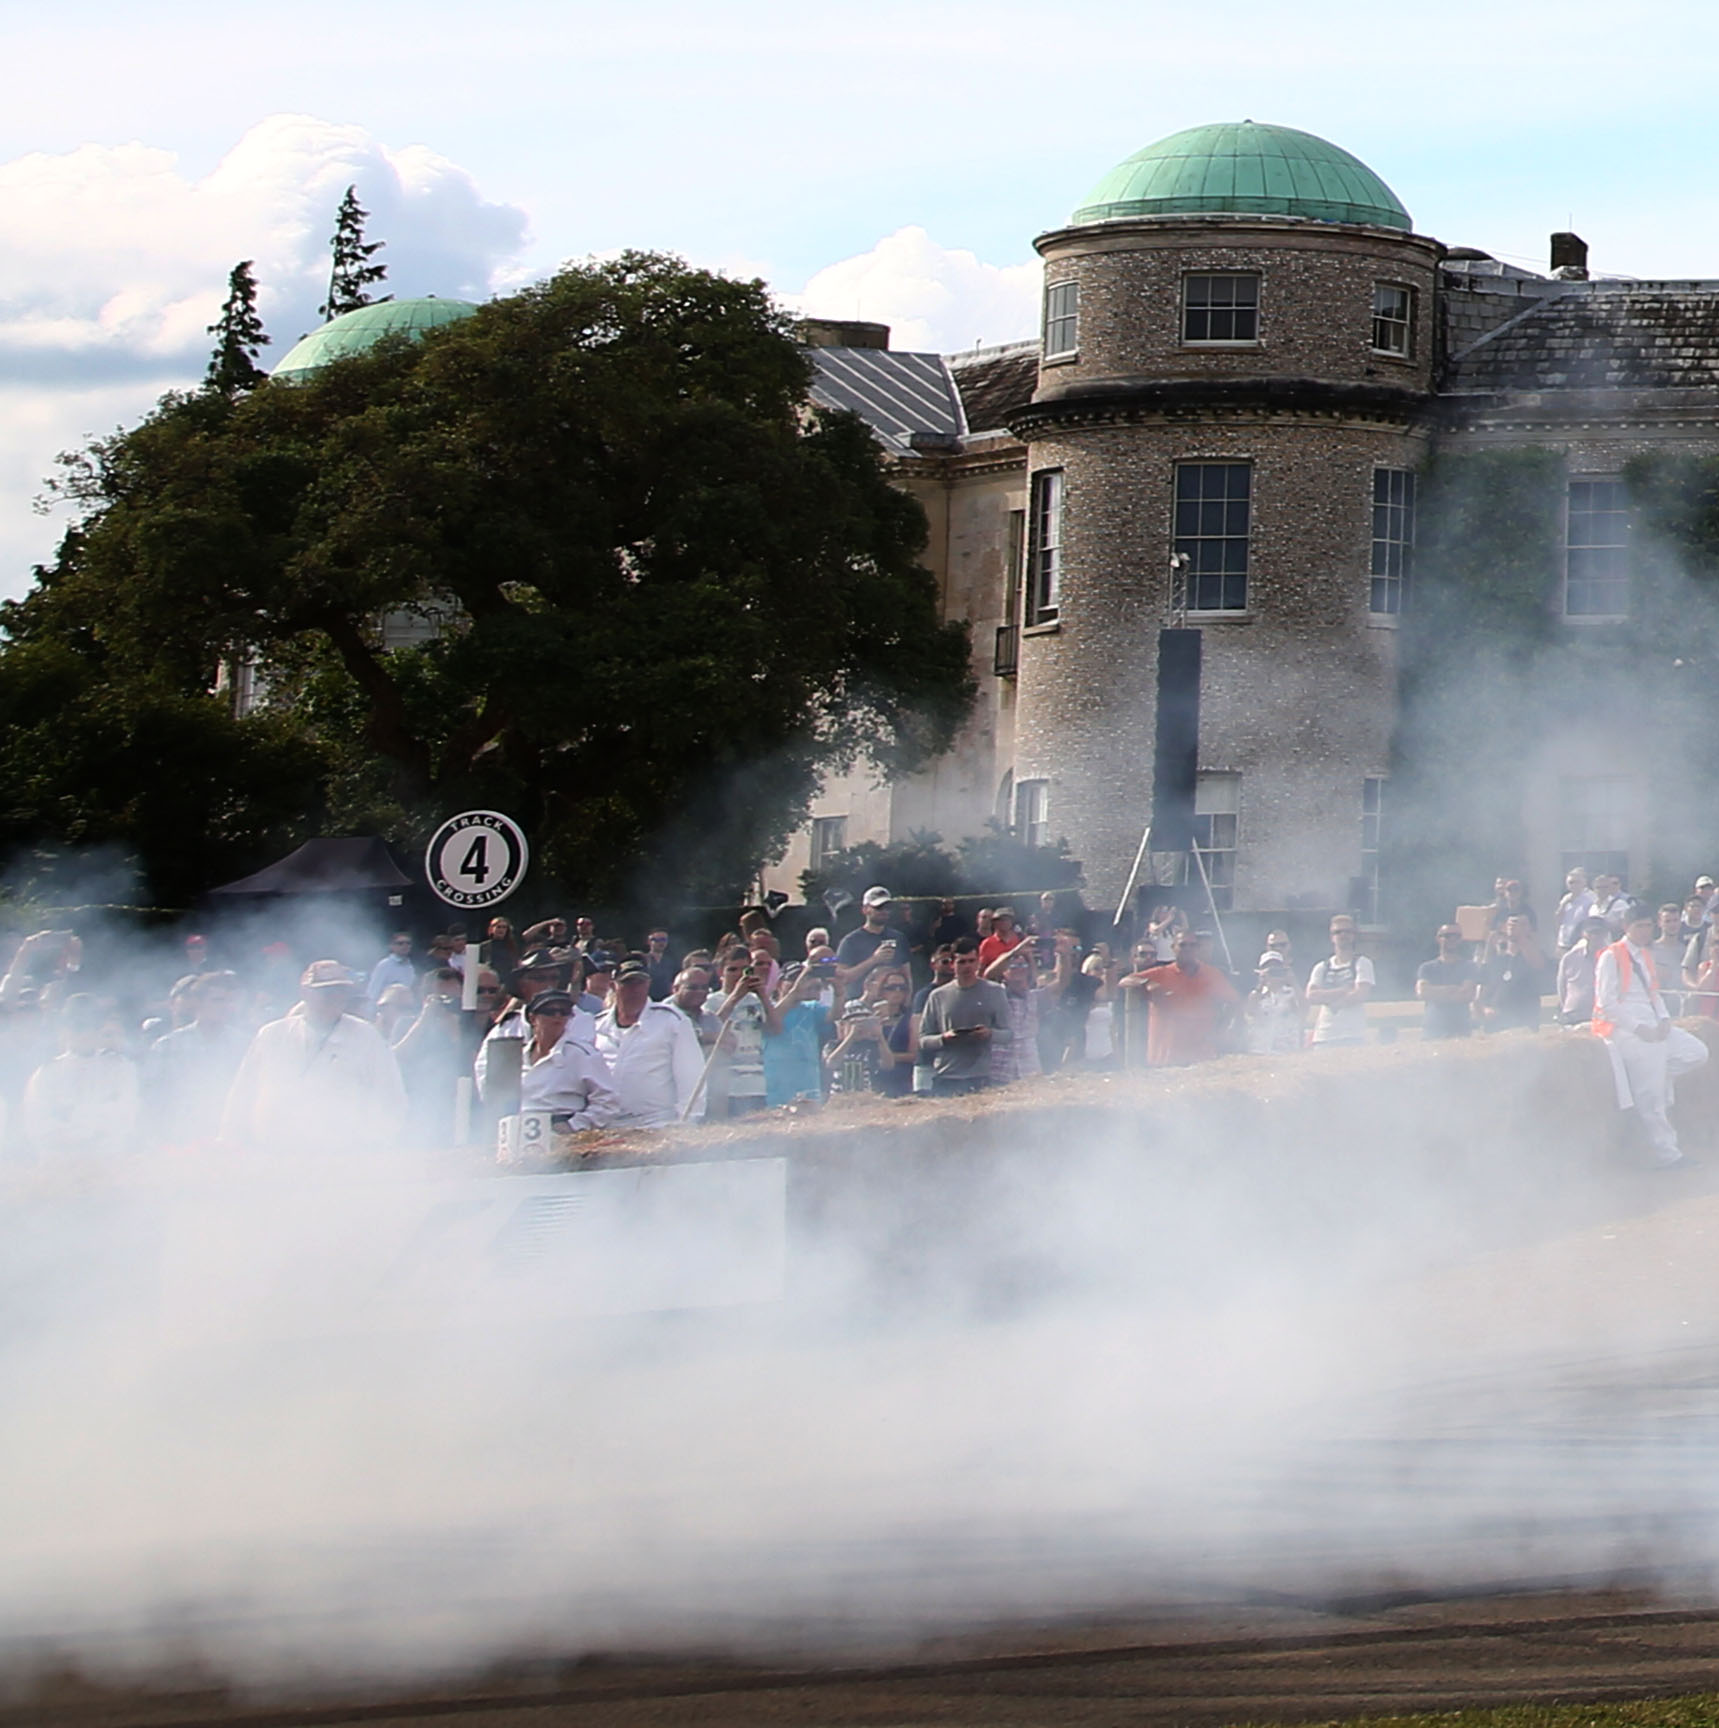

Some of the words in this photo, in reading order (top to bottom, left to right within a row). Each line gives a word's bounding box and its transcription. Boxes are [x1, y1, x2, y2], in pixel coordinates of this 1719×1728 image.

[449, 815, 504, 831] TRACK
[460, 835, 490, 884] 4
[436, 876, 512, 904] CROSSING
[525, 1117, 541, 1141] 3
